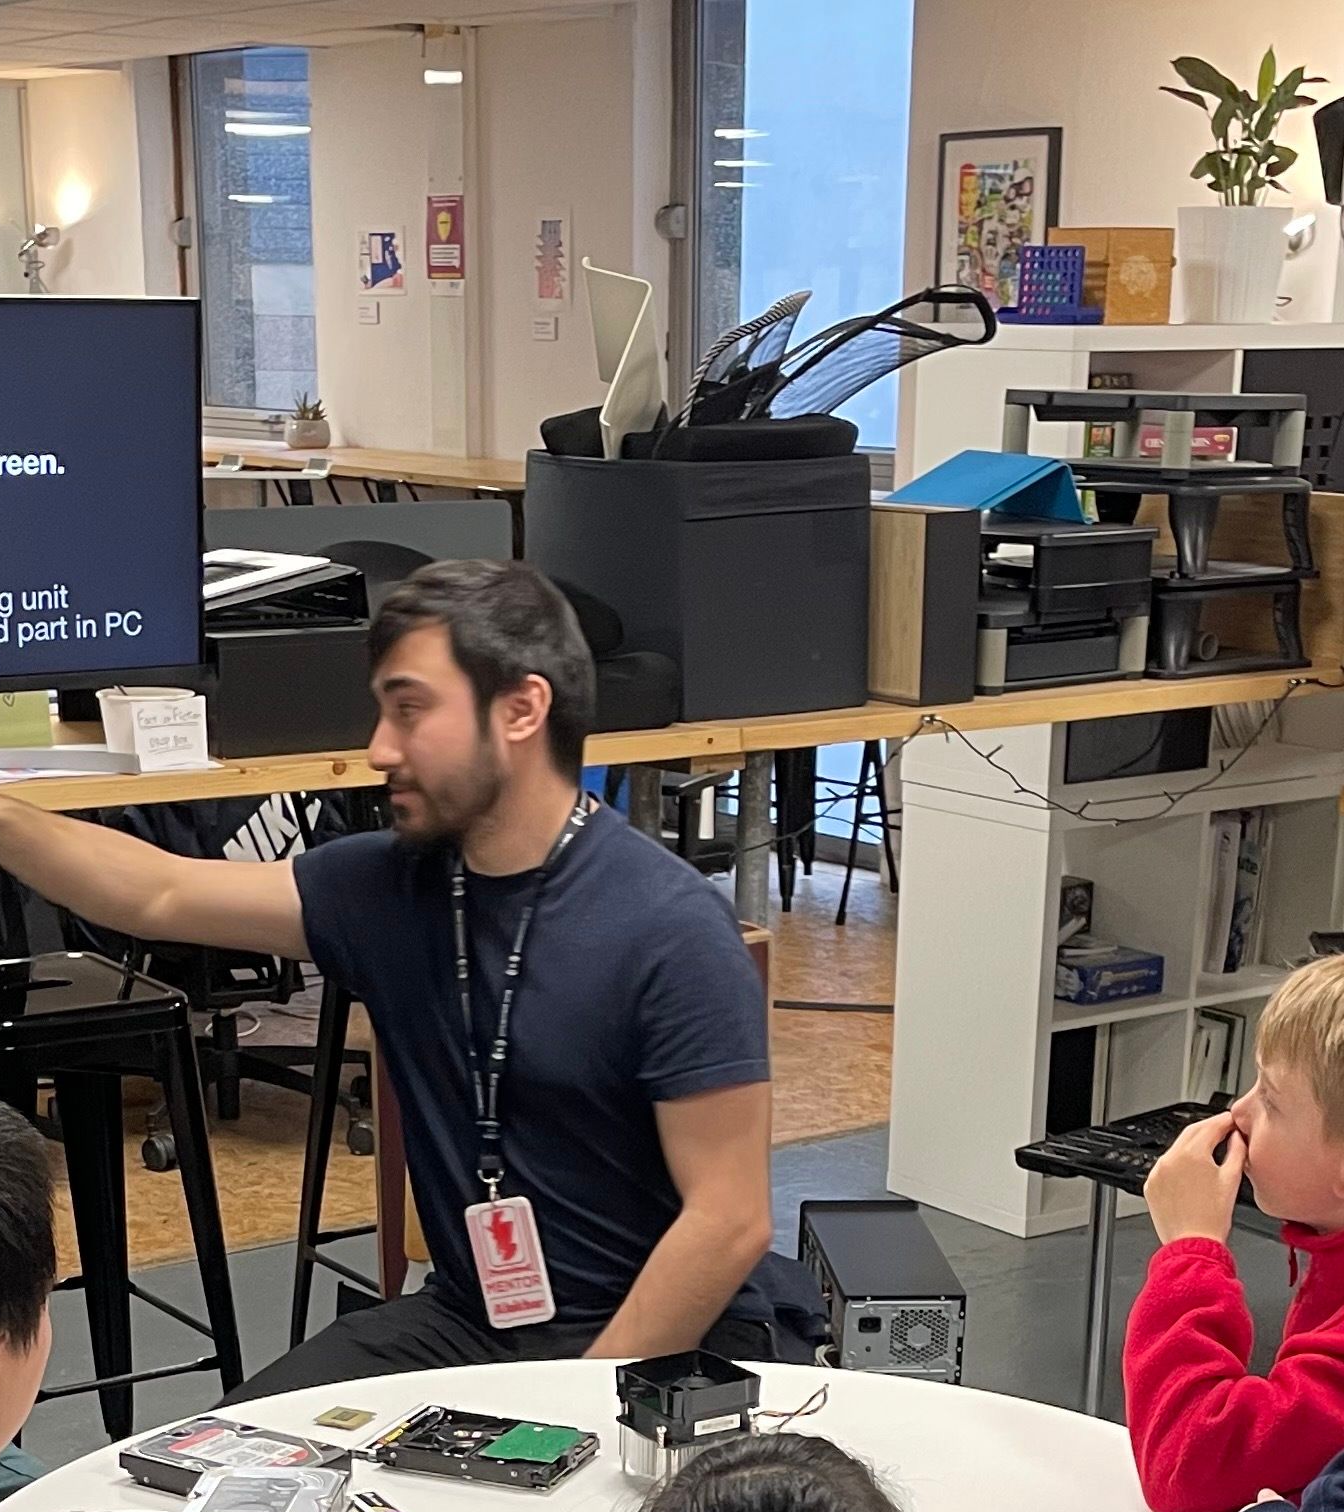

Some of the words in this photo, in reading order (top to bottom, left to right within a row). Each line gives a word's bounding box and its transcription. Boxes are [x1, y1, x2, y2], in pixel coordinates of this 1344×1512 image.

[20, 584, 69, 611] unit
[16, 613, 69, 648] part
[74, 613, 97, 639] in
[102, 610, 142, 638] PC
[486, 1273, 542, 1295] MENTOR
